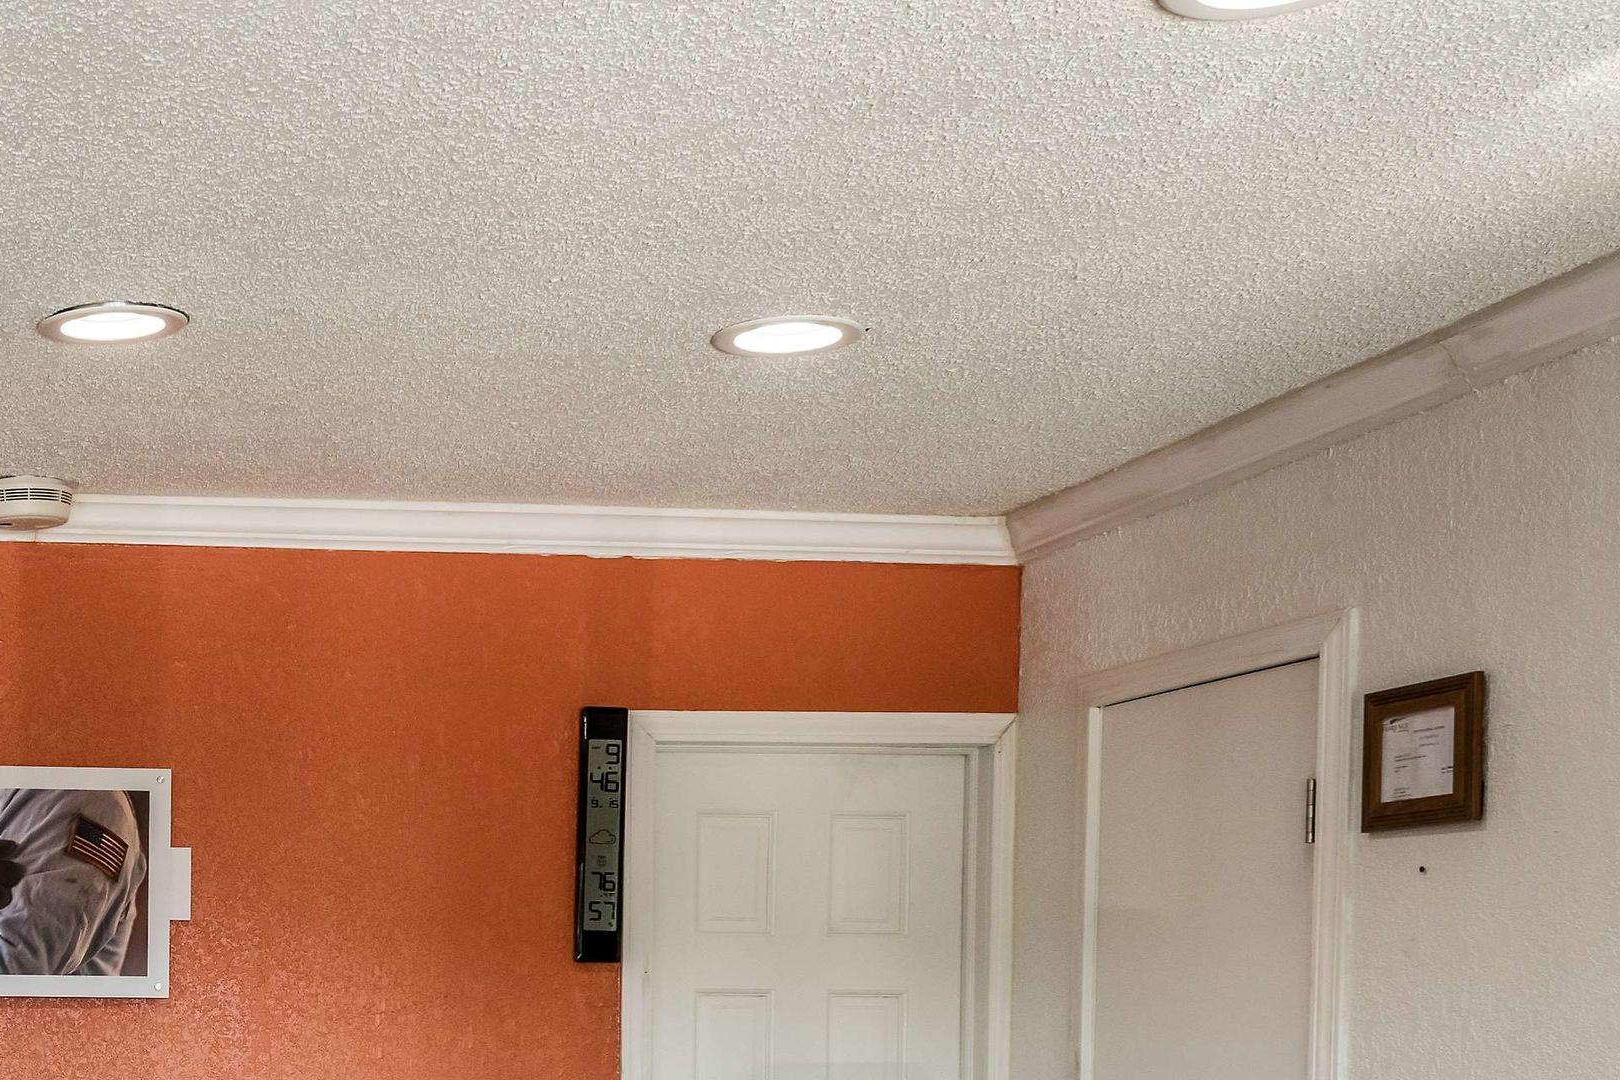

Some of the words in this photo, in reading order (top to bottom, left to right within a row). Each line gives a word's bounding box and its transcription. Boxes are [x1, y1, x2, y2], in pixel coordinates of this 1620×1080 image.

[590, 771, 619, 793] 46
[590, 871, 615, 892] 76
[588, 900, 615, 922] 57
